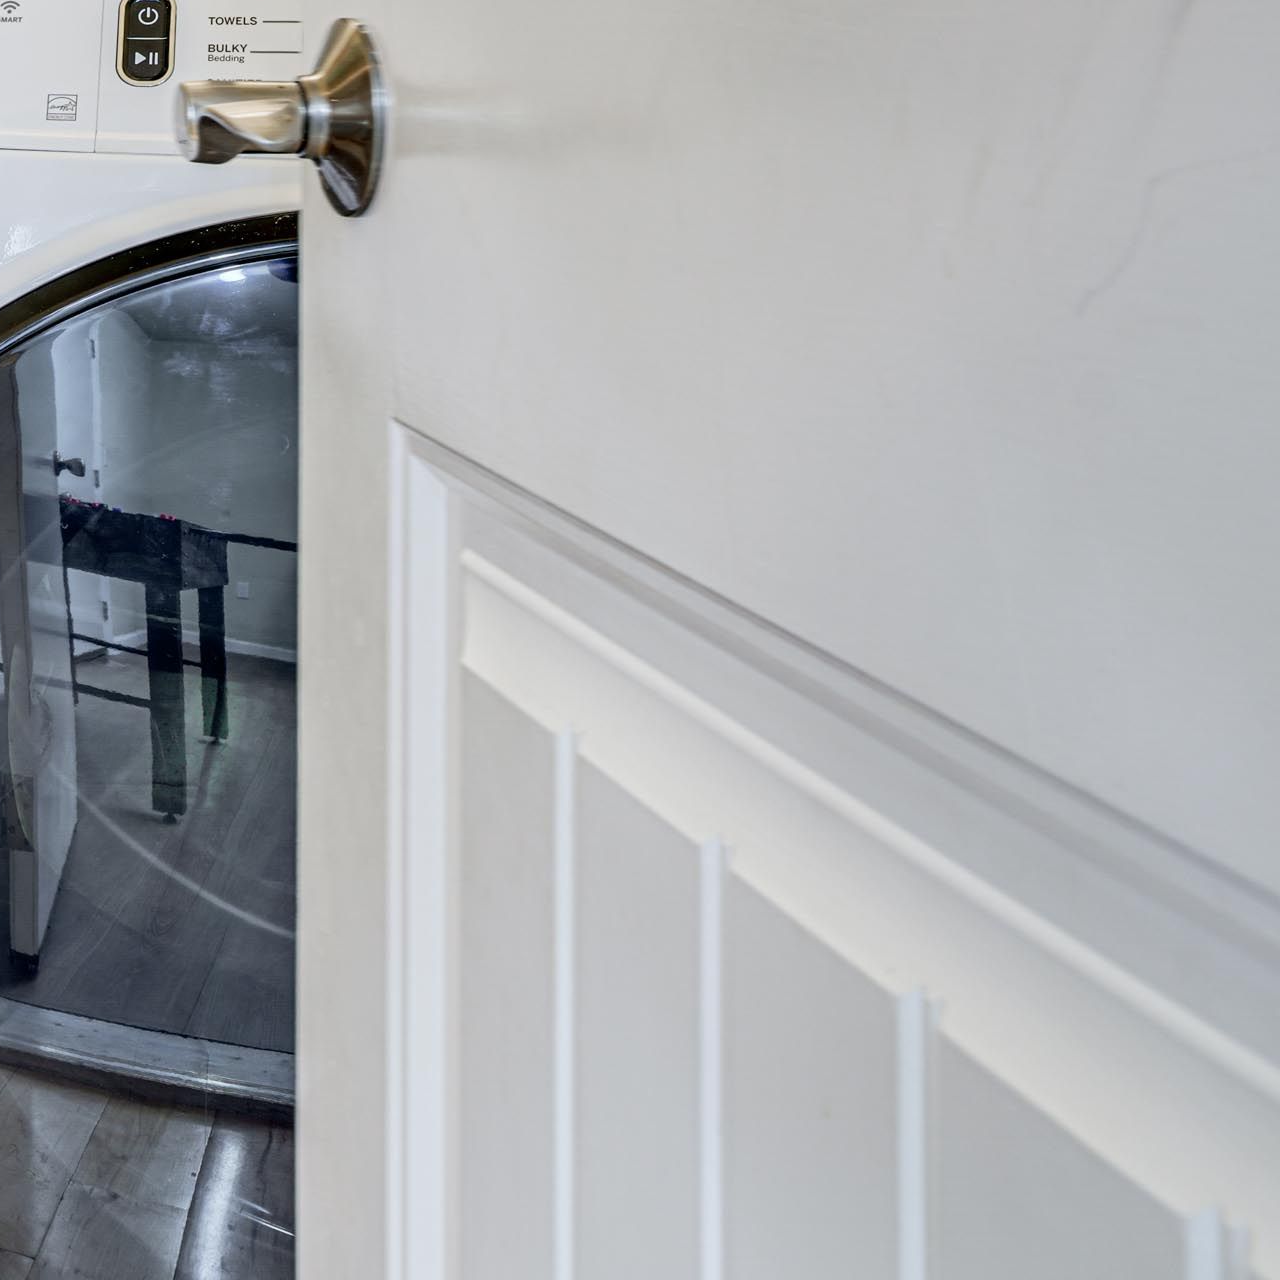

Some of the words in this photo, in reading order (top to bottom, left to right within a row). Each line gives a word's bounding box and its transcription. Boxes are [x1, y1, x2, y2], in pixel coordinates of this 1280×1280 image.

[208, 16, 258, 26] TOWELS
[207, 43, 248, 53] BULKY
[207, 54, 245, 64] Bedding
